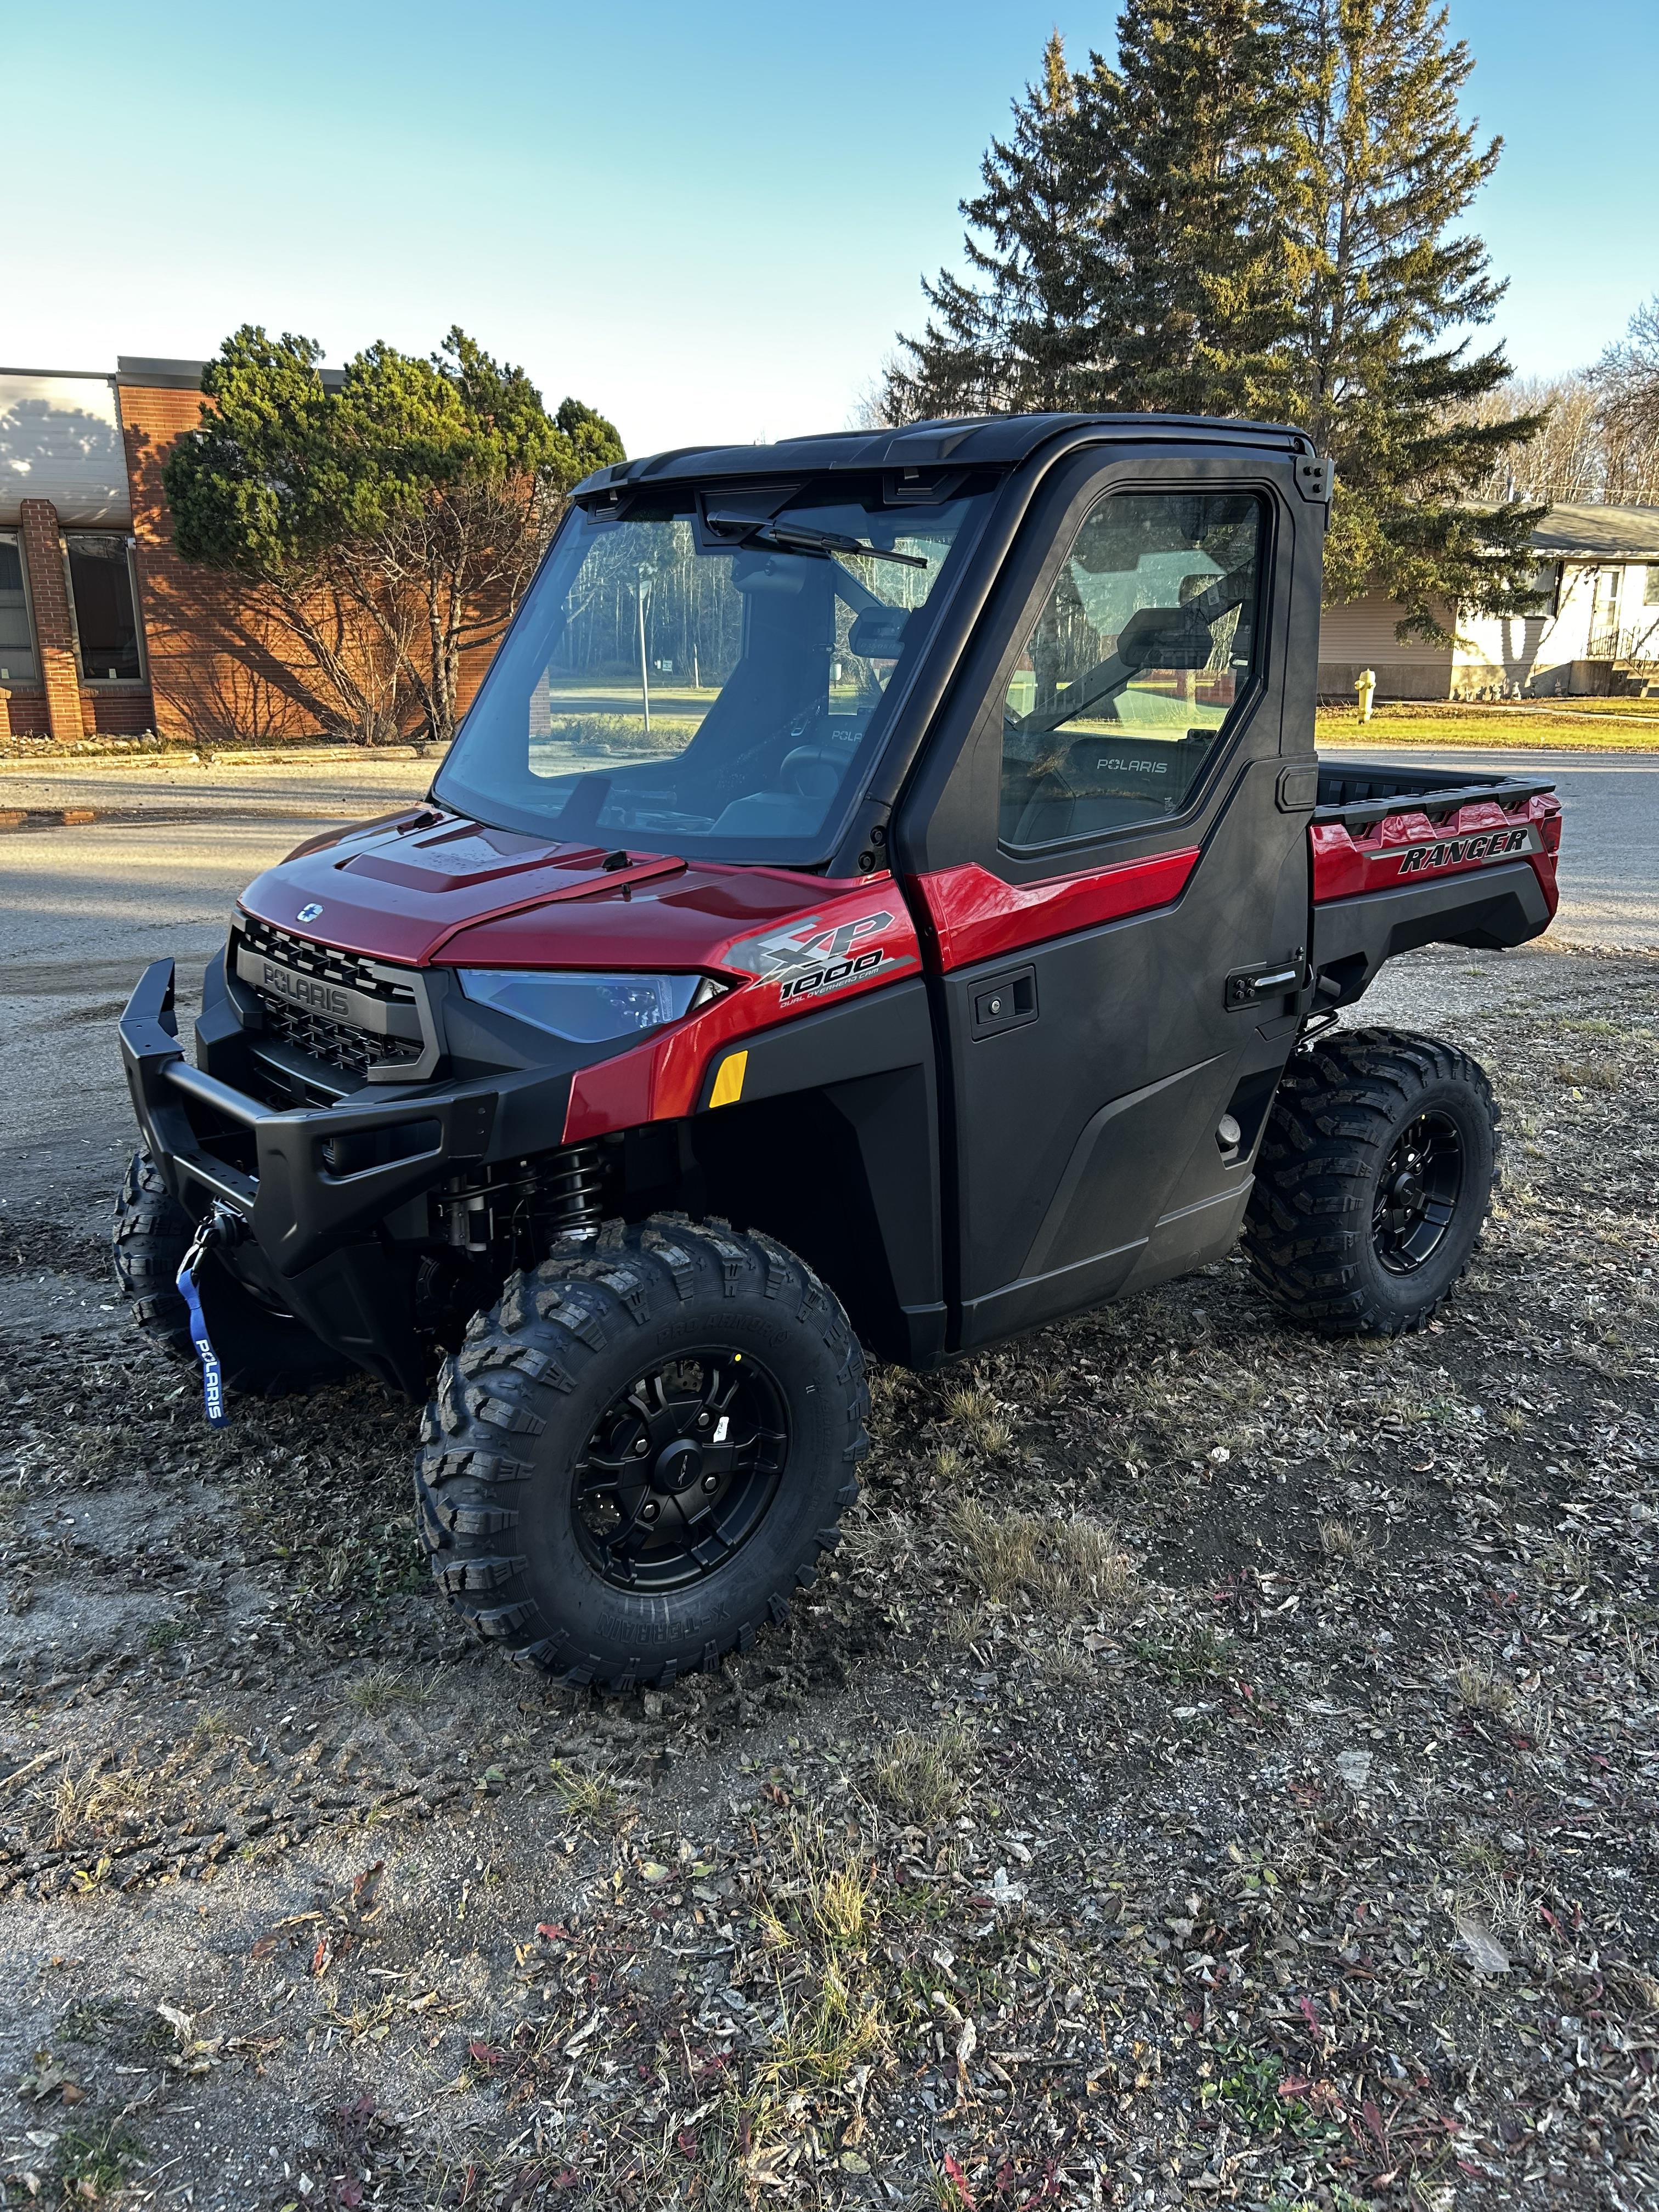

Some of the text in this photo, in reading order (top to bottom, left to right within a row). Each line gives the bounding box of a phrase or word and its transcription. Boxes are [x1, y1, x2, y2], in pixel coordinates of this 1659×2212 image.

[1098, 759, 1167, 774] POLARIS
[1398, 829, 1528, 874] RANGER
[744, 911, 895, 993] XP
[779, 948, 884, 1002] 1000
[264, 963, 348, 1017] POLARIS
[780, 968, 879, 1009] DUAL OVERHEAD CAM
[196, 1339, 222, 1419] POLARIS
[596, 1601, 731, 1645] X-TERRAIN
